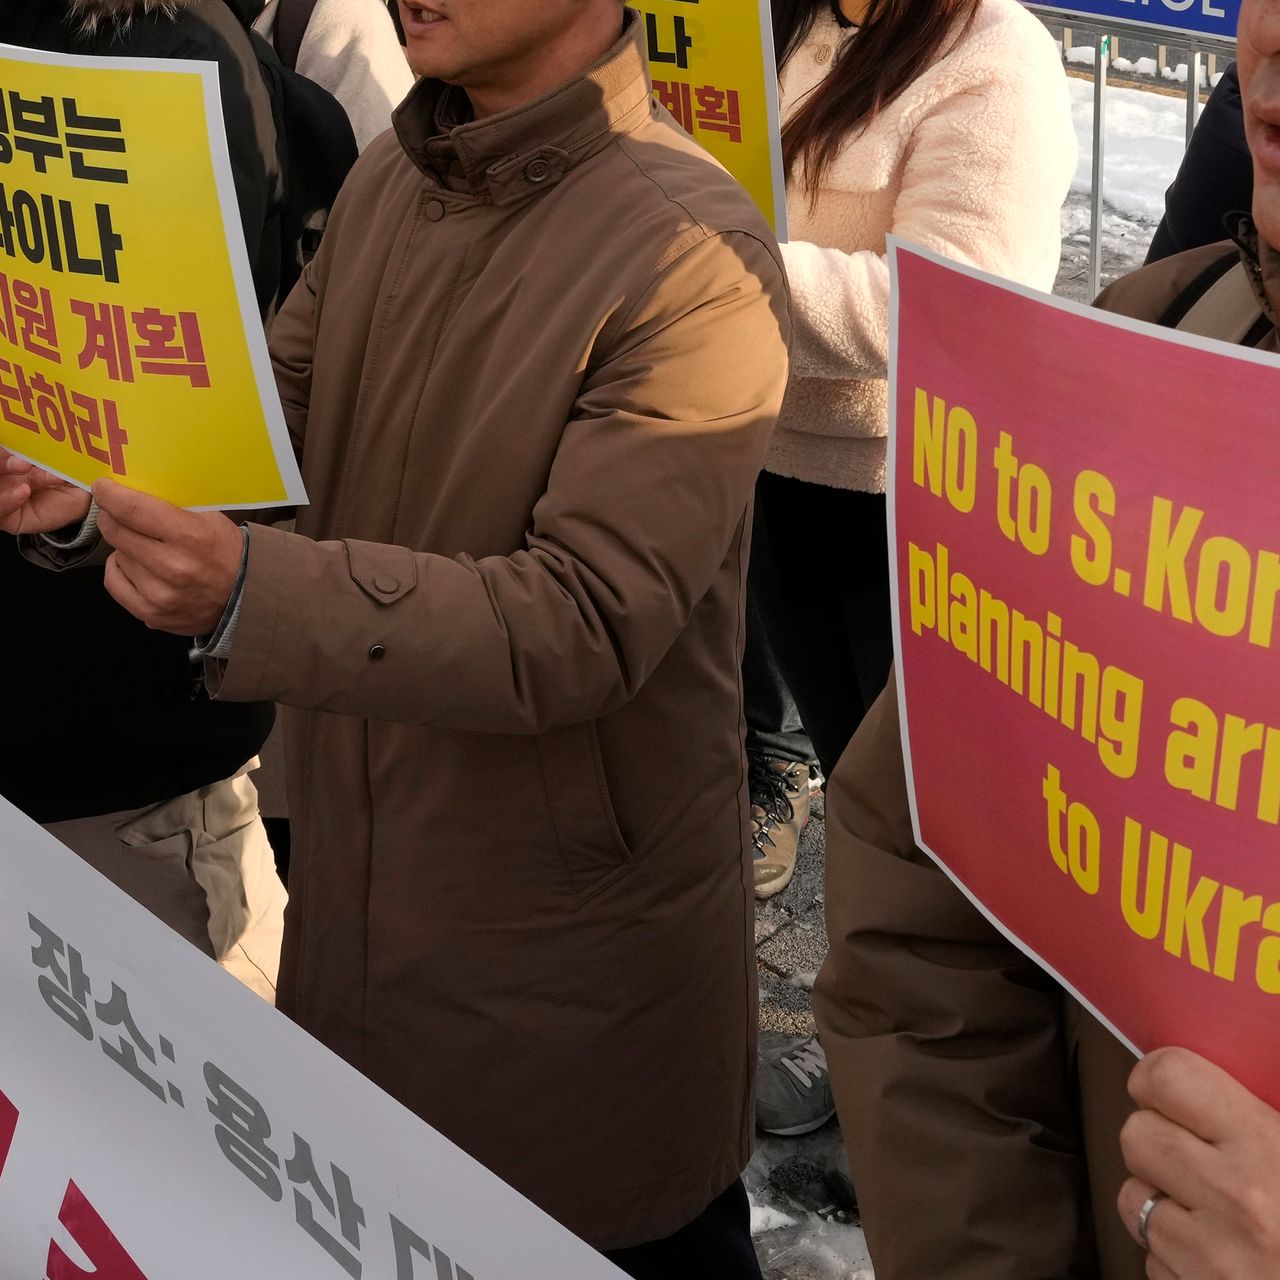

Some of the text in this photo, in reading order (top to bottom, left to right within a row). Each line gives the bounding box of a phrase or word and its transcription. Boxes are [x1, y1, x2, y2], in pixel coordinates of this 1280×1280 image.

[69, 297, 212, 388] 계획
[912, 387, 979, 514] NO
[993, 430, 1052, 558] to
[908, 540, 1144, 780] planning
[1041, 762, 1103, 897] to
[26, 911, 185, 1110] 장소:
[202, 1060, 367, 1280] 용산
